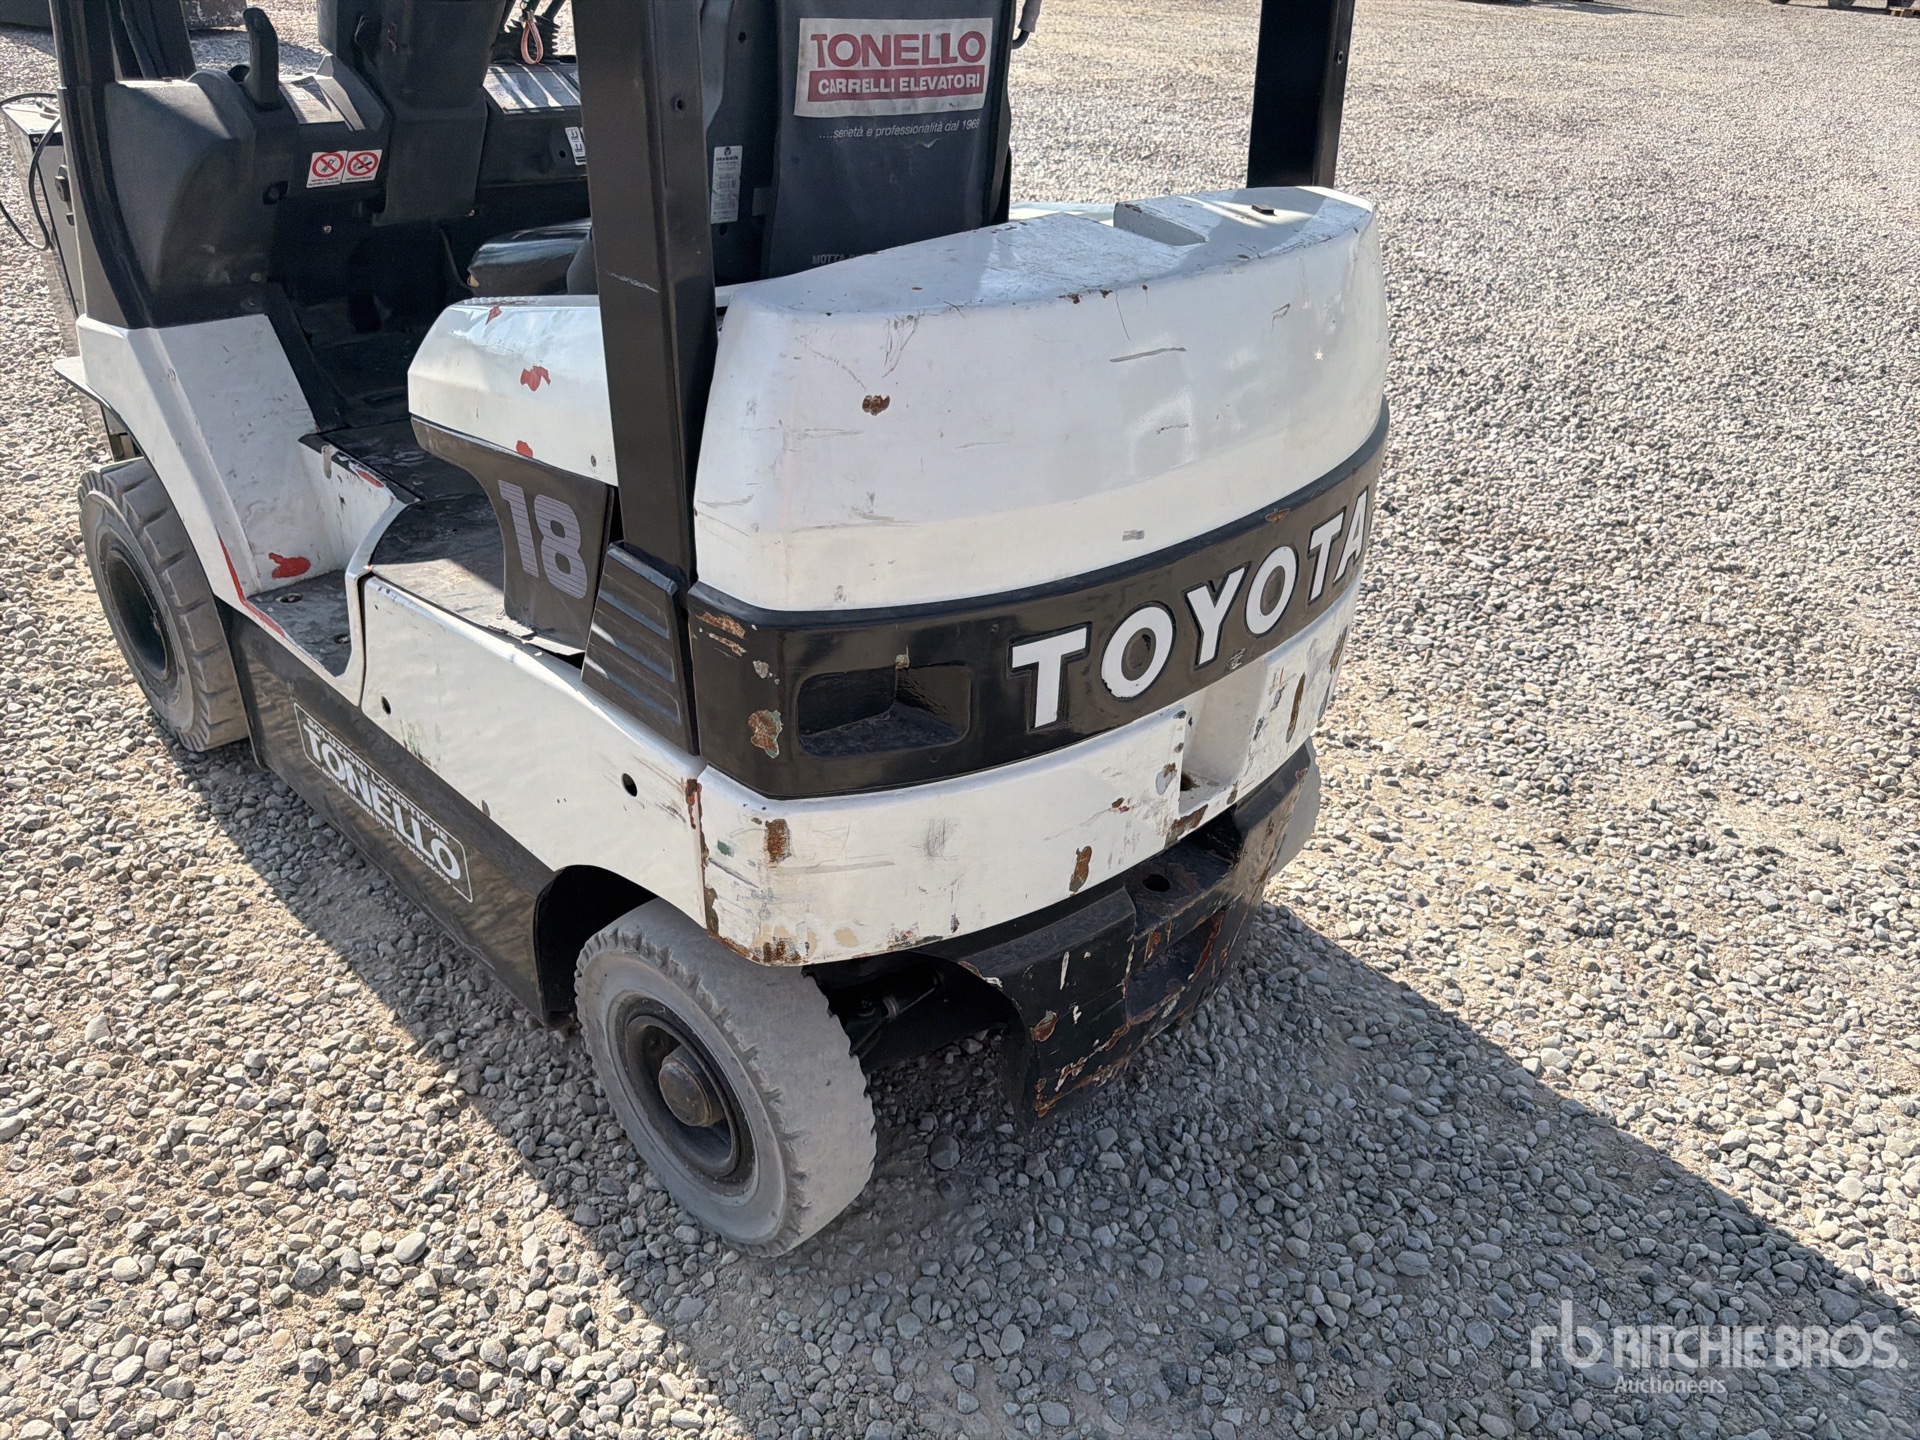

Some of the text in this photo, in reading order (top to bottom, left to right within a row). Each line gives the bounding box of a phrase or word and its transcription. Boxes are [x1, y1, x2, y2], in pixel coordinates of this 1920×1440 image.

[810, 30, 986, 68] TONELLO
[818, 72, 980, 95] CARRELLI ELEVATORI
[866, 129, 873, 137] e
[874, 120, 943, 139] professionalità
[944, 120, 960, 132] dal
[498, 479, 588, 600] 18
[1011, 488, 1369, 729] TOYOTA
[302, 722, 461, 880] TONELLO
[306, 717, 449, 845] SOLUZIONI LOGISTICHE
